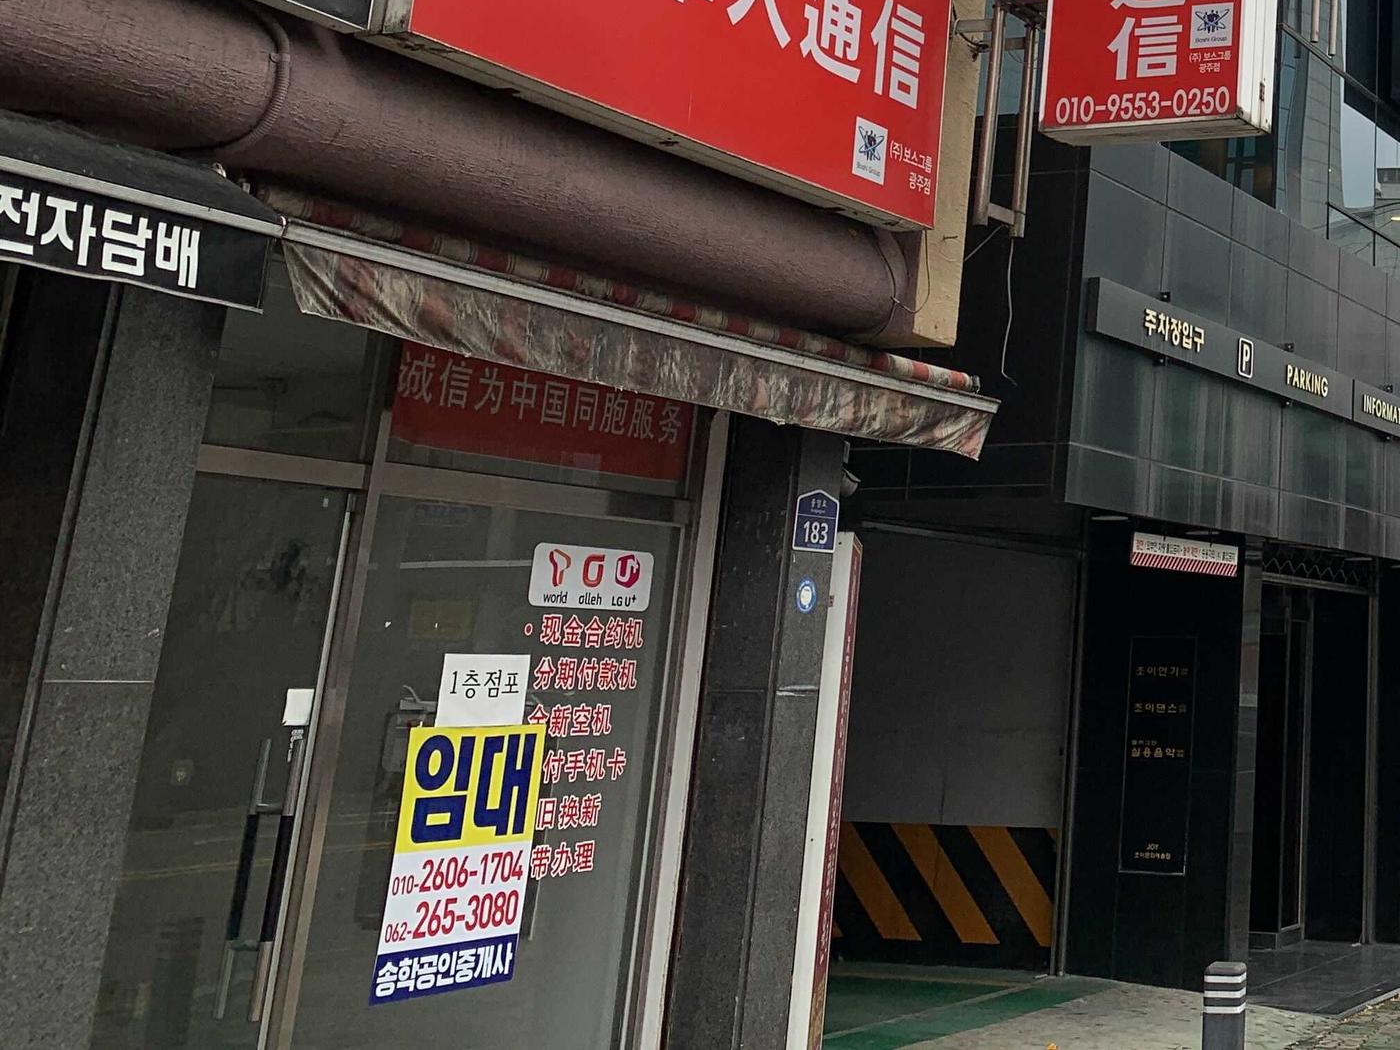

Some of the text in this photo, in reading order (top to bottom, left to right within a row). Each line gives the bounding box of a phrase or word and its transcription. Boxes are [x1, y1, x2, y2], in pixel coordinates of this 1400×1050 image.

[1055, 85, 1230, 125] 010-9553-0250
[1143, 306, 1205, 353] 주차장입구
[1286, 363, 1329, 399] PARKING
[399, 351, 682, 445] 诚信为中国同胞服务
[803, 521, 828, 544] 183
[543, 591, 568, 604] world
[611, 596, 623, 607] LG
[540, 613, 643, 649] 现金合约机
[533, 656, 638, 690] 分期付款机
[543, 747, 627, 784] 付手机卡
[410, 733, 538, 844] 임대
[535, 793, 601, 830] 旧换新
[391, 849, 524, 896] 010-2606-1704
[530, 839, 596, 880] 带办理
[384, 889, 519, 944] 062-265-3080
[375, 941, 513, 997] 송학공인중개사
